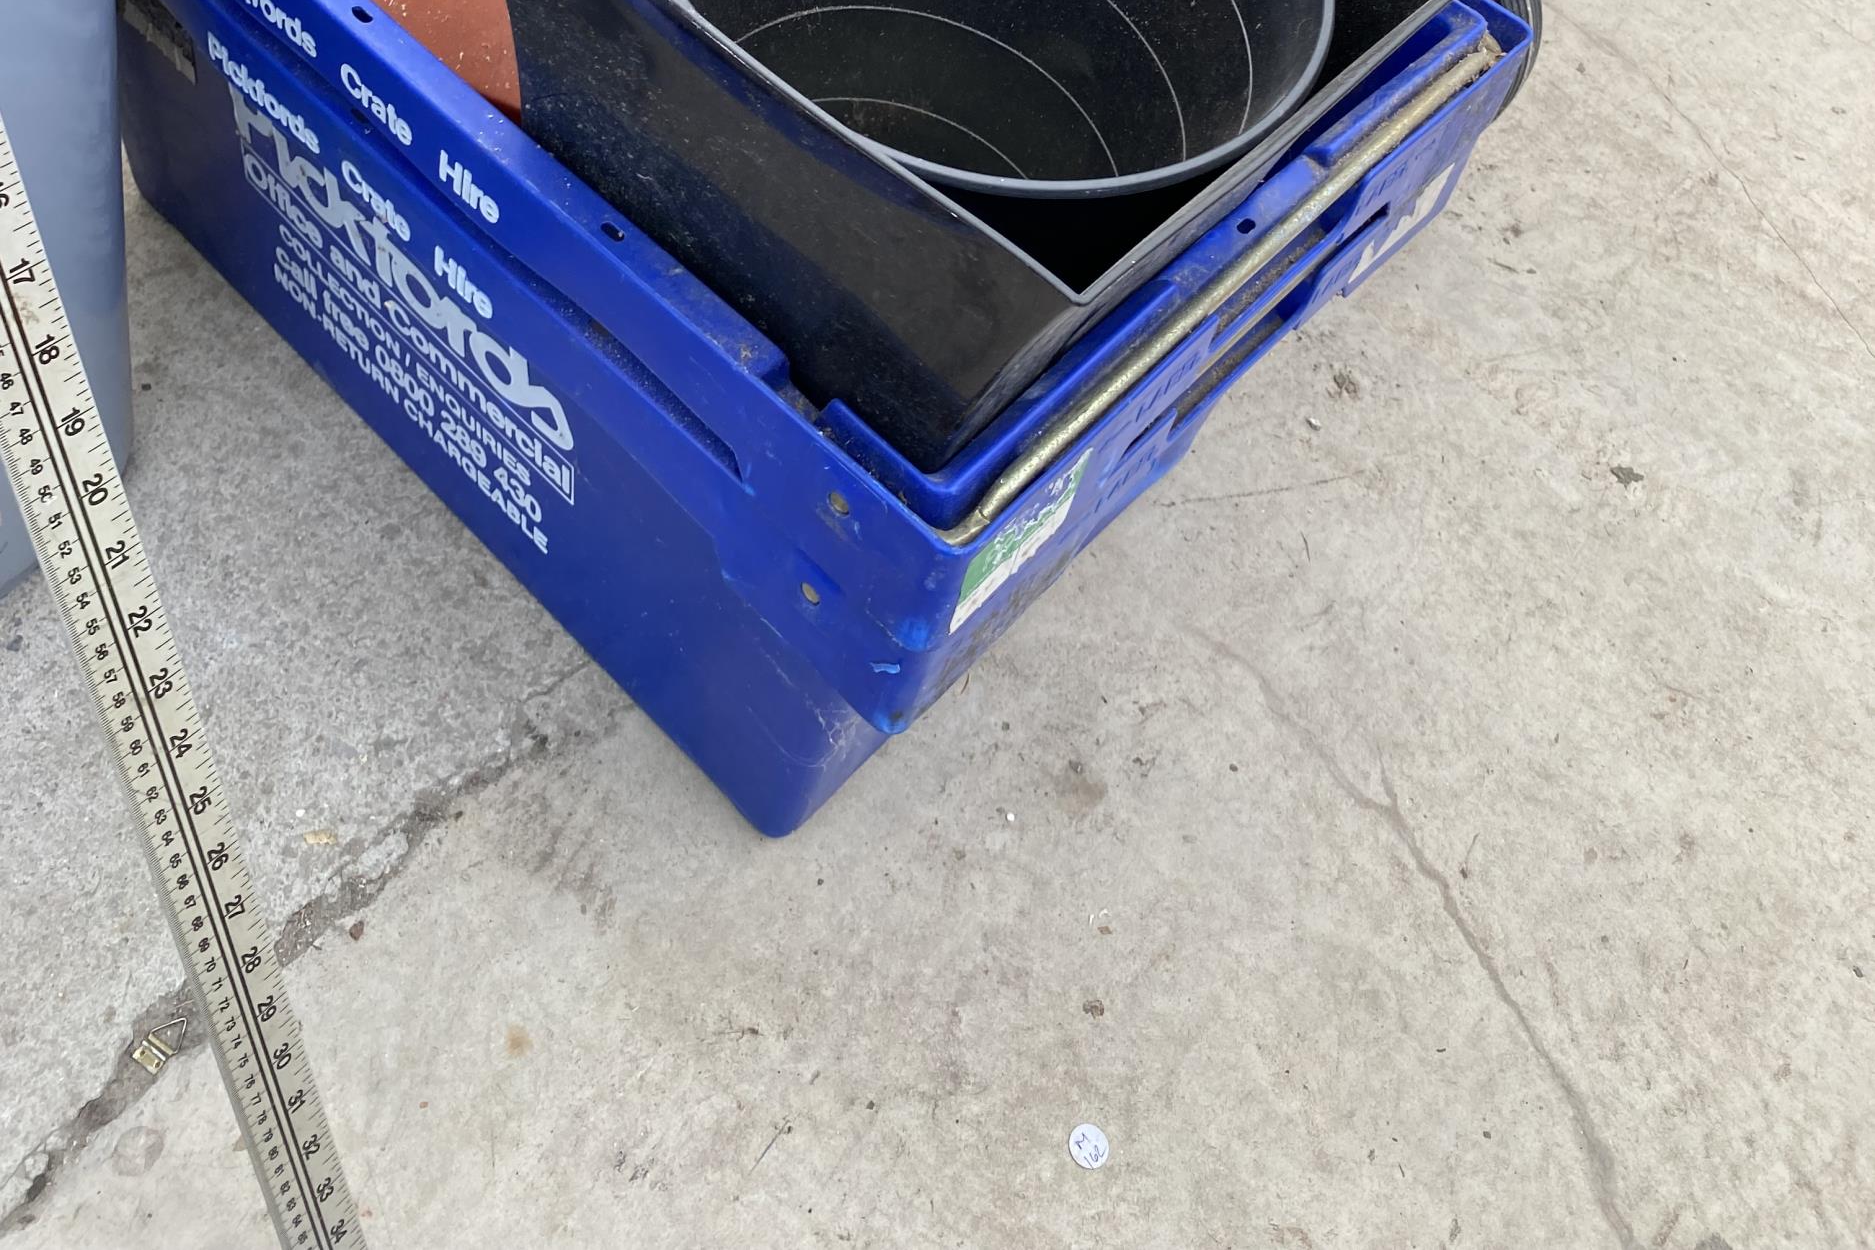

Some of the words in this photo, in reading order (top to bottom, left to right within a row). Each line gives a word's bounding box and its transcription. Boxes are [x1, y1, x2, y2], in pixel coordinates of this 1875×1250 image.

[207, 30, 320, 154] Pickfords
[341, 160, 412, 242] Crate
[434, 245, 493, 319] Hire
[341, 63, 413, 146] Crate
[439, 150, 500, 224] Hire
[245, 153, 323, 249] Office
[330, 245, 381, 310] and
[384, 300, 571, 495] Commercial
[273, 262, 400, 404] NON-RETURN
[404, 399, 548, 555] CHARGEABLE
[275, 246, 318, 301] call
[323, 290, 369, 351] free
[375, 345, 435, 417] 0800
[440, 410, 487, 468] 289
[494, 467, 542, 523] 430
[279, 224, 400, 359] COLLECTION
[416, 362, 531, 486] ENQUIRIES
[0, 372, 15, 391] 46
[9, 401, 24, 416] 47
[18, 428, 34, 445] 48
[29, 458, 43, 476] 49
[48, 511, 63, 530] 51
[58, 540, 73, 559] 52
[67, 566, 82, 585] 53
[76, 591, 91, 609] 54
[85, 618, 100, 636] 55
[95, 643, 109, 660] 56
[104, 668, 118, 684] 57
[112, 691, 126, 709] 58
[121, 715, 135, 732] 59
[129, 739, 143, 756] 60
[137, 762, 150, 778] 61
[145, 786, 159, 803] 62
[154, 809, 167, 826] 63
[161, 830, 175, 847] 64
[169, 852, 182, 869] 65
[176, 873, 189, 890] 66
[184, 894, 197, 909] 67
[191, 916, 204, 932] 68
[198, 937, 210, 953] 69
[204, 956, 216, 973] 70
[211, 977, 223, 992] 71
[218, 996, 230, 1013] 72
[225, 1016, 236, 1032] 73
[231, 1033, 242, 1050] 74
[237, 1052, 249, 1069] 75
[244, 1073, 256, 1089] 76
[250, 1092, 262, 1106] 77
[256, 1109, 268, 1125] 78
[262, 1127, 273, 1143] 79
[9, 258, 36, 284] 17
[35, 334, 60, 365] 18
[61, 407, 85, 437] 19
[82, 473, 108, 506] 20
[105, 540, 130, 570] 21
[128, 605, 152, 638] 22
[149, 668, 173, 699] 23
[169, 728, 192, 759] 24
[189, 786, 212, 815] 25
[207, 842, 229, 871] 26
[225, 894, 245, 919] 27
[241, 946, 262, 974] 28
[257, 995, 277, 1022] 29
[273, 1042, 292, 1070] 30
[288, 1089, 306, 1114] 31
[302, 1134, 320, 1160] 32
[316, 1177, 334, 1203] 33
[330, 1219, 347, 1245] 34
